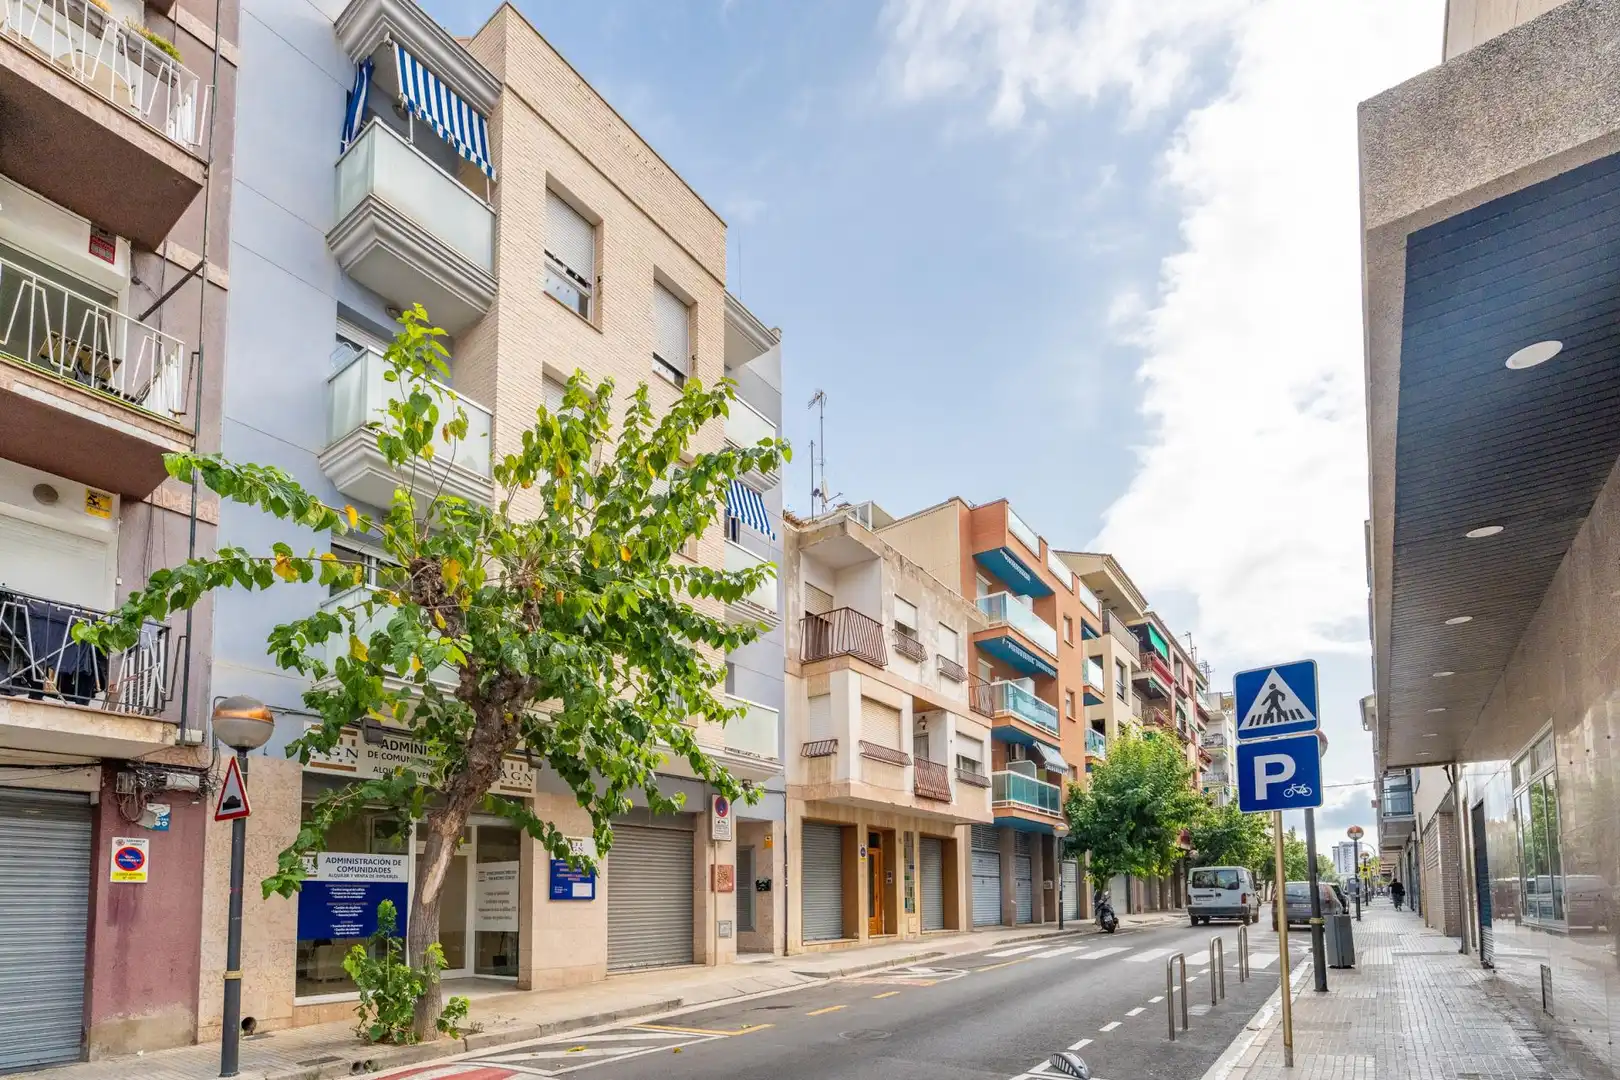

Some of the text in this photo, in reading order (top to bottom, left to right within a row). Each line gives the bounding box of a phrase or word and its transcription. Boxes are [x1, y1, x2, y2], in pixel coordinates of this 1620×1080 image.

[367, 750, 379, 759] DE
[1254, 754, 1296, 800] P
[325, 856, 391, 866] ADMINISTRACIÓN
[336, 865, 392, 874] COMUNIDADES
